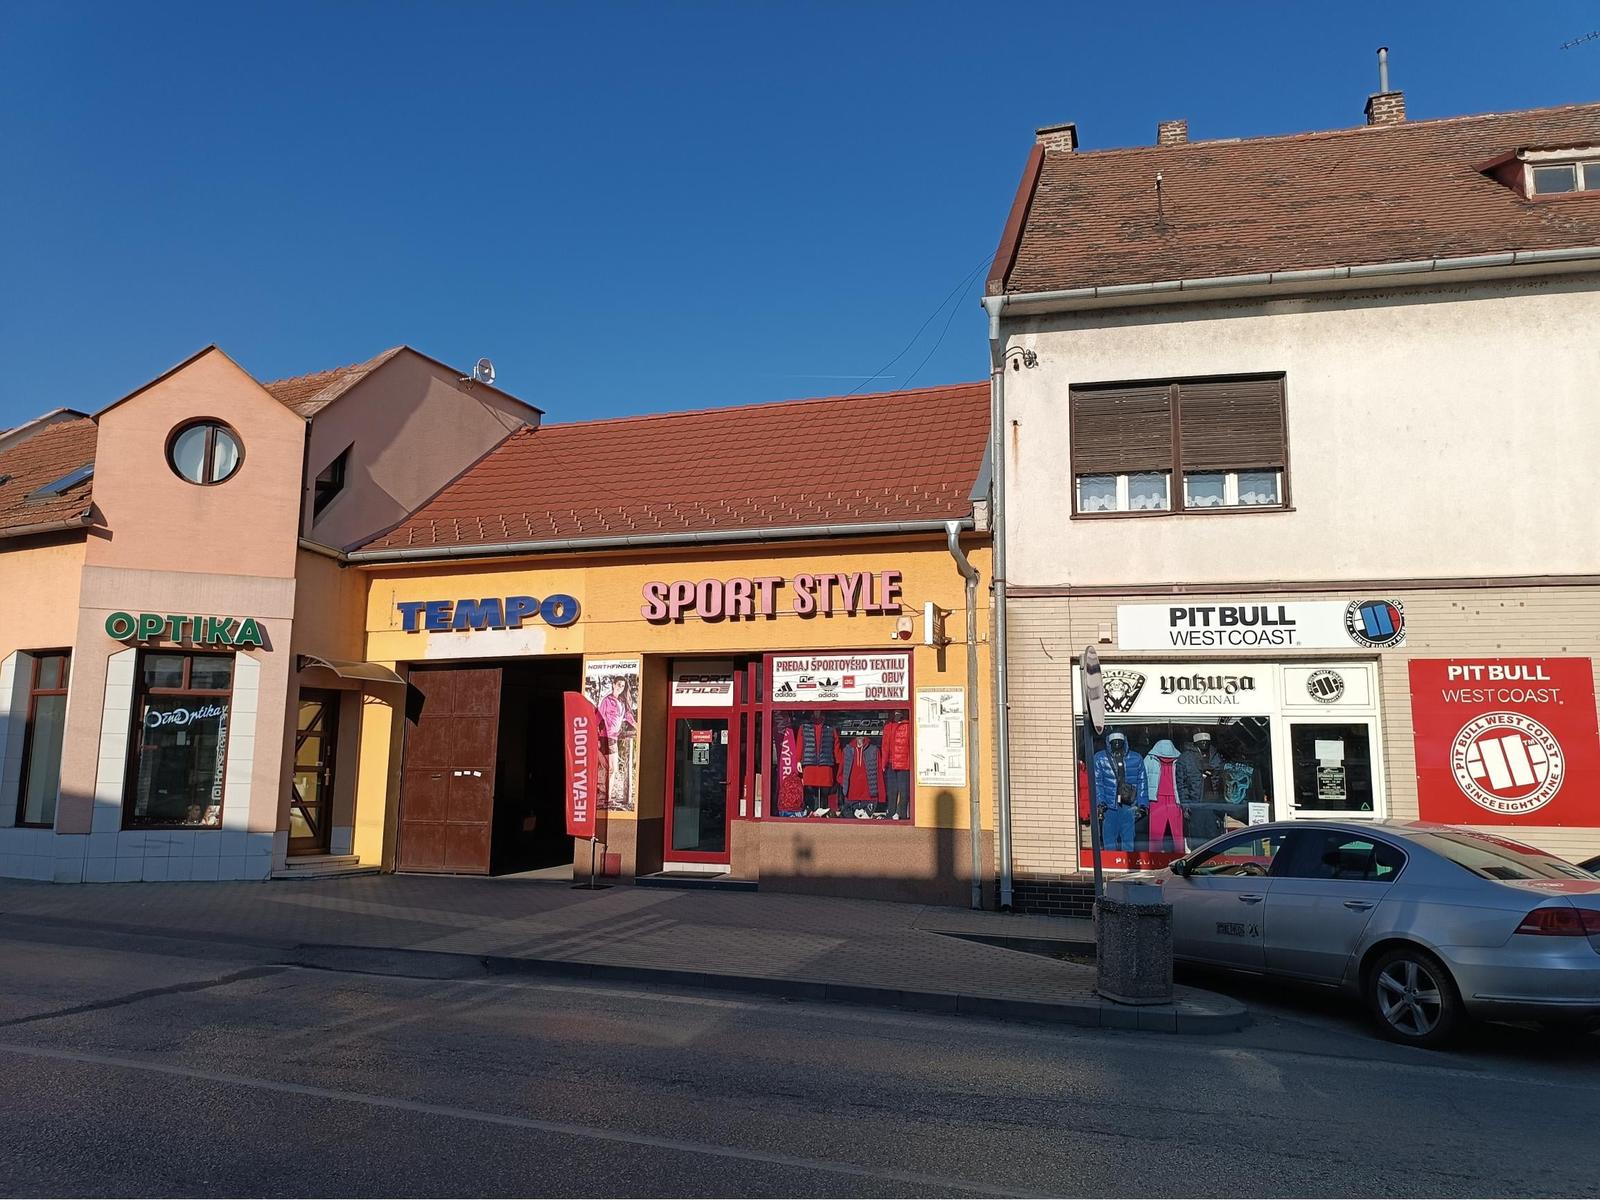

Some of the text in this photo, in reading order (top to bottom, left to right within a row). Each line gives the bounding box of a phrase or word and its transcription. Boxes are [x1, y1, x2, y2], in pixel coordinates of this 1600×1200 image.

[641, 571, 902, 622] SPORT STYLE
[397, 593, 581, 633] TEMPO
[1169, 605, 1296, 627] PIT BULL
[105, 611, 264, 646] OPTIKA
[1169, 629, 1296, 646] WEST COAST
[776, 660, 809, 672] PREDAJ
[869, 658, 905, 670] TEXTILU
[1447, 665, 1551, 681] PIT BULL
[865, 686, 905, 699] DOPLNKY
[1177, 694, 1240, 705] ORIGINAL
[1442, 688, 1560, 703] WEST COAST
[1455, 715, 1559, 770] PIT BULL WEST COAST
[1465, 782, 1496, 808] SINCE
